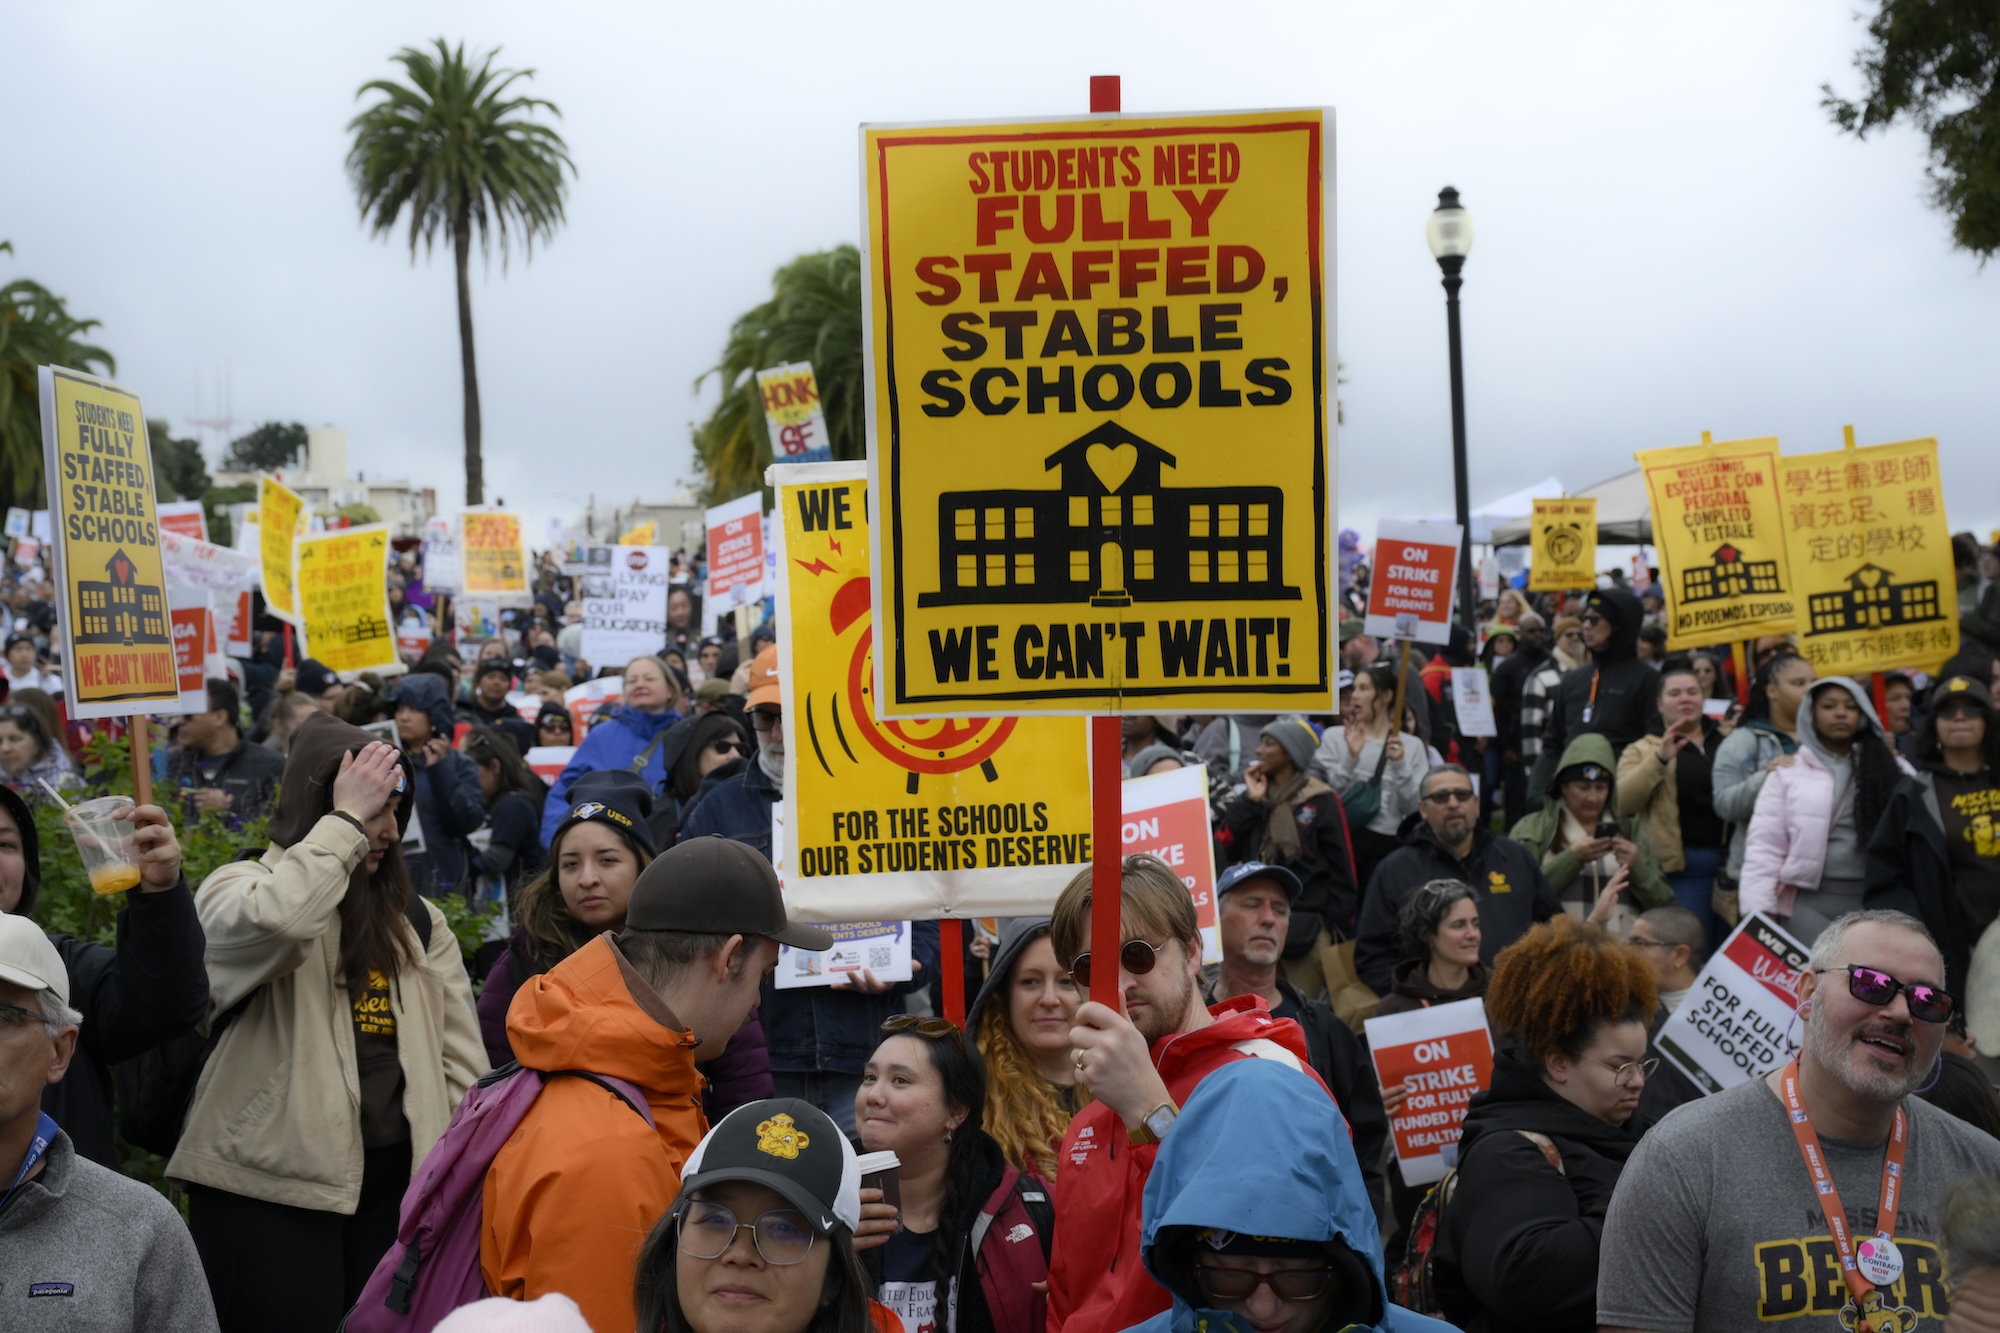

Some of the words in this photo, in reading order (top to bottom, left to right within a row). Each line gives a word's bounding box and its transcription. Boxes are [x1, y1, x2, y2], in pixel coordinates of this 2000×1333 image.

[968, 145, 1141, 194] STUDENTS
[1153, 142, 1241, 186] NEED
[976, 188, 1229, 246] FULLY
[915, 245, 1289, 306] STAFFED,
[941, 303, 1244, 361] STABLE
[759, 376, 821, 413] HONK
[920, 357, 1293, 417] SCHOOLS
[75, 400, 116, 429] STUDENTS
[117, 410, 135, 434] NEED
[78, 424, 134, 459] FULLY
[780, 421, 814, 458] SF
[64, 452, 150, 496] STAFFED,
[1664, 474, 1730, 499] ESCUELAS
[1734, 471, 1765, 488] CON
[1785, 454, 1932, 497] 學生需要師
[72, 484, 145, 517] STABLE
[797, 486, 853, 532] WE
[1683, 490, 1751, 511] PERSONAL
[68, 514, 156, 547] SCHOOLS
[725, 518, 743, 536] ON
[1683, 507, 1751, 528] COMPLETO
[1690, 528, 1699, 544] Y
[1704, 523, 1755, 542] ESTABLE
[1807, 524, 1927, 565] 定的學校
[1402, 546, 1428, 563] ON
[619, 572, 666, 587] LYING
[1387, 564, 1440, 584] STRIKE
[619, 589, 650, 603] PAY
[1384, 597, 1435, 613] STUDENTS
[1388, 584, 1409, 597] FOR
[1410, 586, 1434, 599] OUR
[587, 601, 626, 616] OUR
[1679, 614, 1693, 629] NO
[1694, 602, 1748, 623] PODEMOS
[928, 624, 999, 684] WE
[1013, 621, 1145, 679] CAN'T
[1158, 618, 1291, 677] WAIT!
[1805, 626, 1953, 667] 我們不能等待
[79, 654, 103, 687] WE
[104, 653, 140, 686] CAN'T
[140, 652, 173, 685] WAIT!
[607, 808, 633, 827] UESF
[832, 810, 878, 843] FOR
[886, 807, 931, 838] THE
[938, 802, 1049, 836] SCHOOLS
[1122, 816, 1160, 844] ON
[801, 846, 850, 878] OUR
[857, 839, 978, 872] STUDENTS
[985, 832, 1092, 868] DESERVE
[857, 924, 898, 938] DESERVE
[1757, 928, 1788, 956] WE
[361, 1023, 379, 1033] EST.
[1703, 976, 1741, 1013] FOR
[1742, 1009, 1802, 1056] FULLY
[1686, 1010, 1764, 1078] SCHOOL
[1701, 1000, 1775, 1065] STAFFED
[1413, 1039, 1451, 1064] ON
[1403, 1064, 1477, 1094] STRIKE
[1407, 1094, 1438, 1111] FOR
[1439, 1086, 1480, 1105] FULLY
[1394, 1111, 1450, 1133] FUNDED
[1407, 1129, 1463, 1149] HEALTH
[1805, 1143, 1821, 1168] STRIKE
[1814, 1167, 1825, 1179] ON
[1887, 1176, 1896, 1190] ON
[1884, 1188, 1896, 1213] STRIKE
[1805, 1206, 1932, 1236] MSSON
[1832, 1215, 1846, 1243] STRIKE
[1839, 1242, 1850, 1254] ON
[1875, 1252, 1890, 1261] FAIR
[1862, 1256, 1901, 1272] CONTRACT
[1871, 1266, 1890, 1276] NOW
[32, 1288, 69, 1297] patagonia
[1754, 1235, 1949, 1322] BEAR
